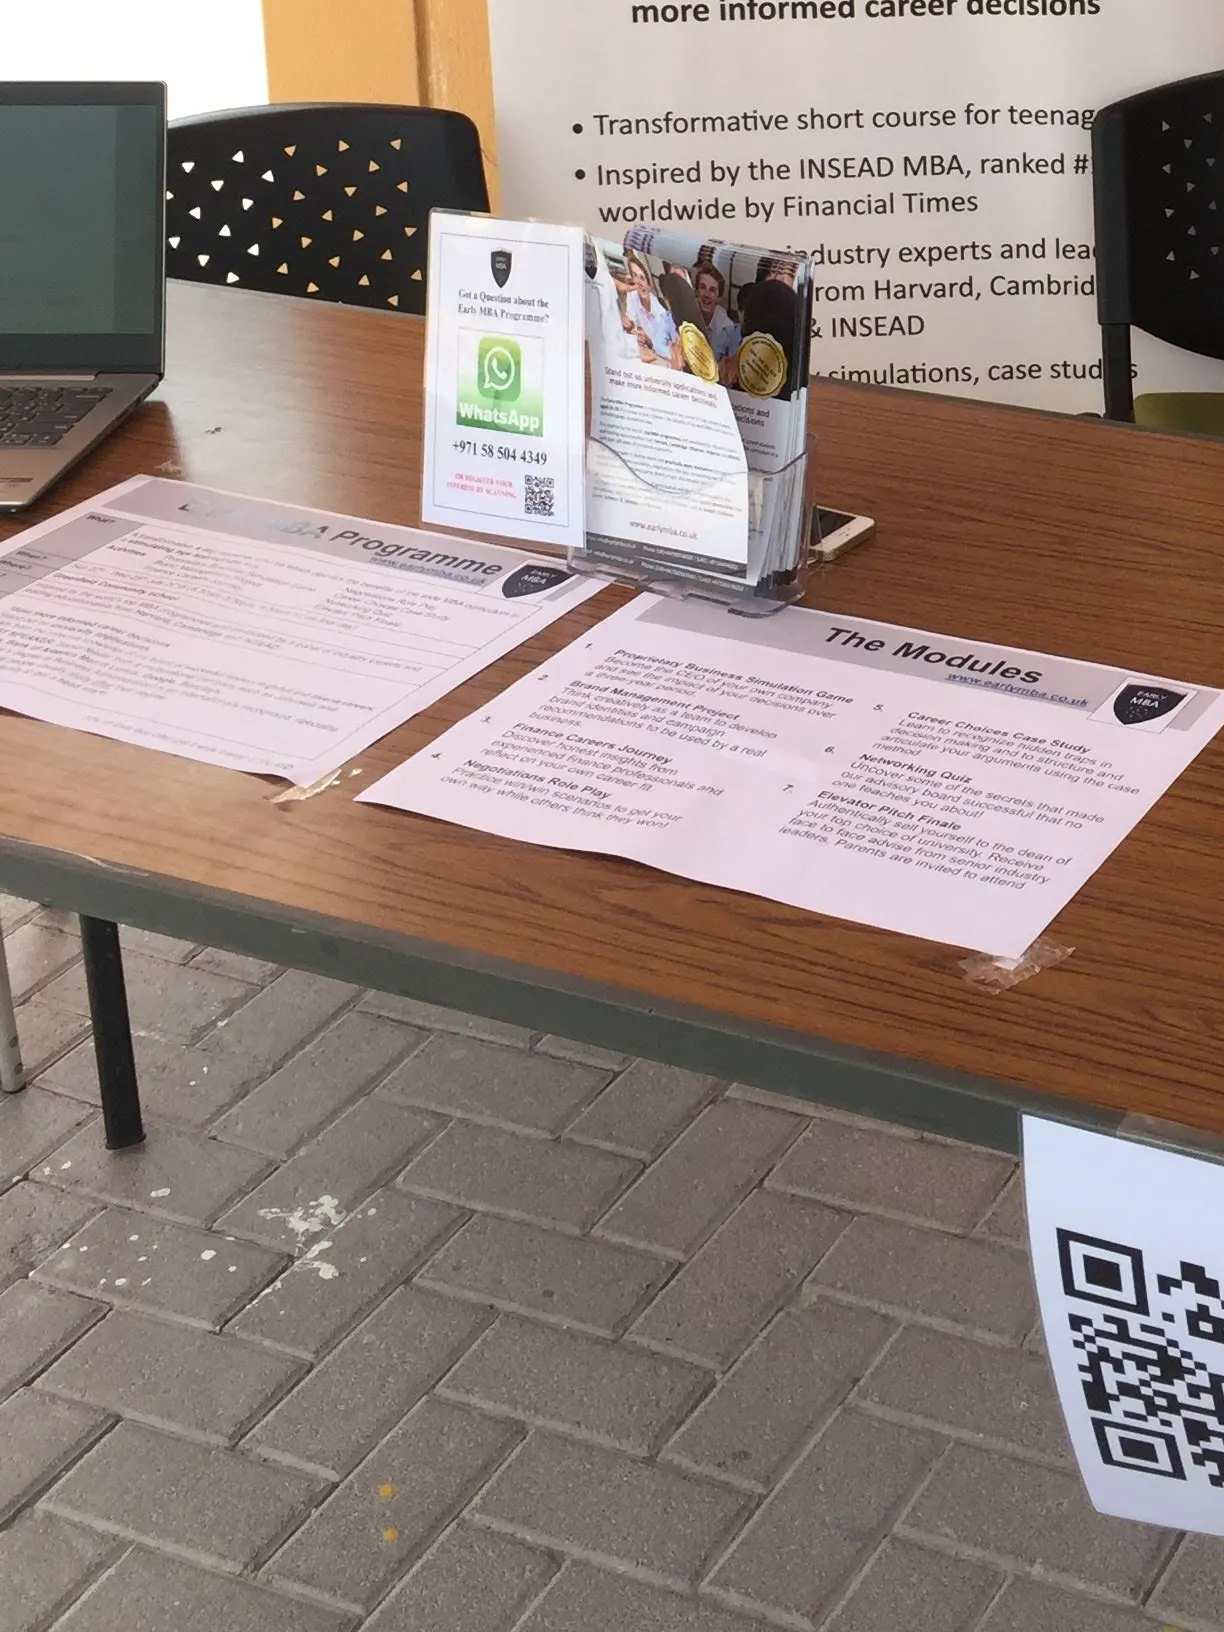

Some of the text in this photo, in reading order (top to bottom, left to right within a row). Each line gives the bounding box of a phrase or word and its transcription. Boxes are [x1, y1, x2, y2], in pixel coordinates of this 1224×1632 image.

[632, 3, 710, 23] more
[592, 109, 789, 136] Transformative
[797, 107, 865, 130] short
[872, 109, 956, 128] course
[964, 102, 1001, 125] for
[597, 160, 701, 190] Inspired
[710, 159, 741, 187] by
[747, 158, 791, 181] the
[800, 156, 894, 180] INSEAD
[903, 154, 971, 179] MBA,
[980, 152, 1065, 175] ranked
[598, 192, 978, 223] worldwide by Financial Times
[898, 241, 992, 267] experts
[1000, 237, 1046, 260] and
[459, 289, 472, 299] Got
[479, 291, 512, 304] Question
[513, 296, 535, 307] about
[537, 298, 550, 309] the
[874, 275, 981, 301] Harvard,
[458, 304, 549, 324] Early MBA Programme?
[832, 315, 925, 338] INSEAD
[987, 363, 1042, 382] case
[1050, 357, 1138, 380] studs
[459, 402, 541, 432] WhatsApp
[453, 440, 548, 466] +971 58 504 4349
[328, 530, 504, 576] Programme
[520, 574, 549, 586] MBA
[824, 627, 1044, 684] The Modules
[613, 649, 684, 668] Proprietary
[684, 663, 744, 681] Business
[745, 676, 814, 695] Simulation
[815, 690, 854, 703] Game
[945, 671, 1090, 708] www.earlymba.co.uk
[569, 680, 611, 693] Brand
[609, 687, 692, 710] Management
[692, 704, 740, 721] Project
[1128, 696, 1160, 710] MBA
[1135, 689, 1168, 702] EARLY
[512, 722, 564, 738] Finance
[566, 733, 617, 750] Careers
[617, 745, 673, 765] Journey
[908, 711, 953, 726] Career
[954, 721, 1009, 737] Choices
[1012, 732, 1047, 745] Case
[1050, 739, 1091, 754] Study
[463, 759, 546, 783] Negotiations
[547, 777, 579, 790] Role
[580, 785, 612, 800] Play
[858, 753, 938, 778] Networking
[940, 771, 973, 784] Quiz
[817, 790, 877, 810] Elevator
[877, 805, 915, 820] Pitch
[917, 814, 961, 831] Finale
